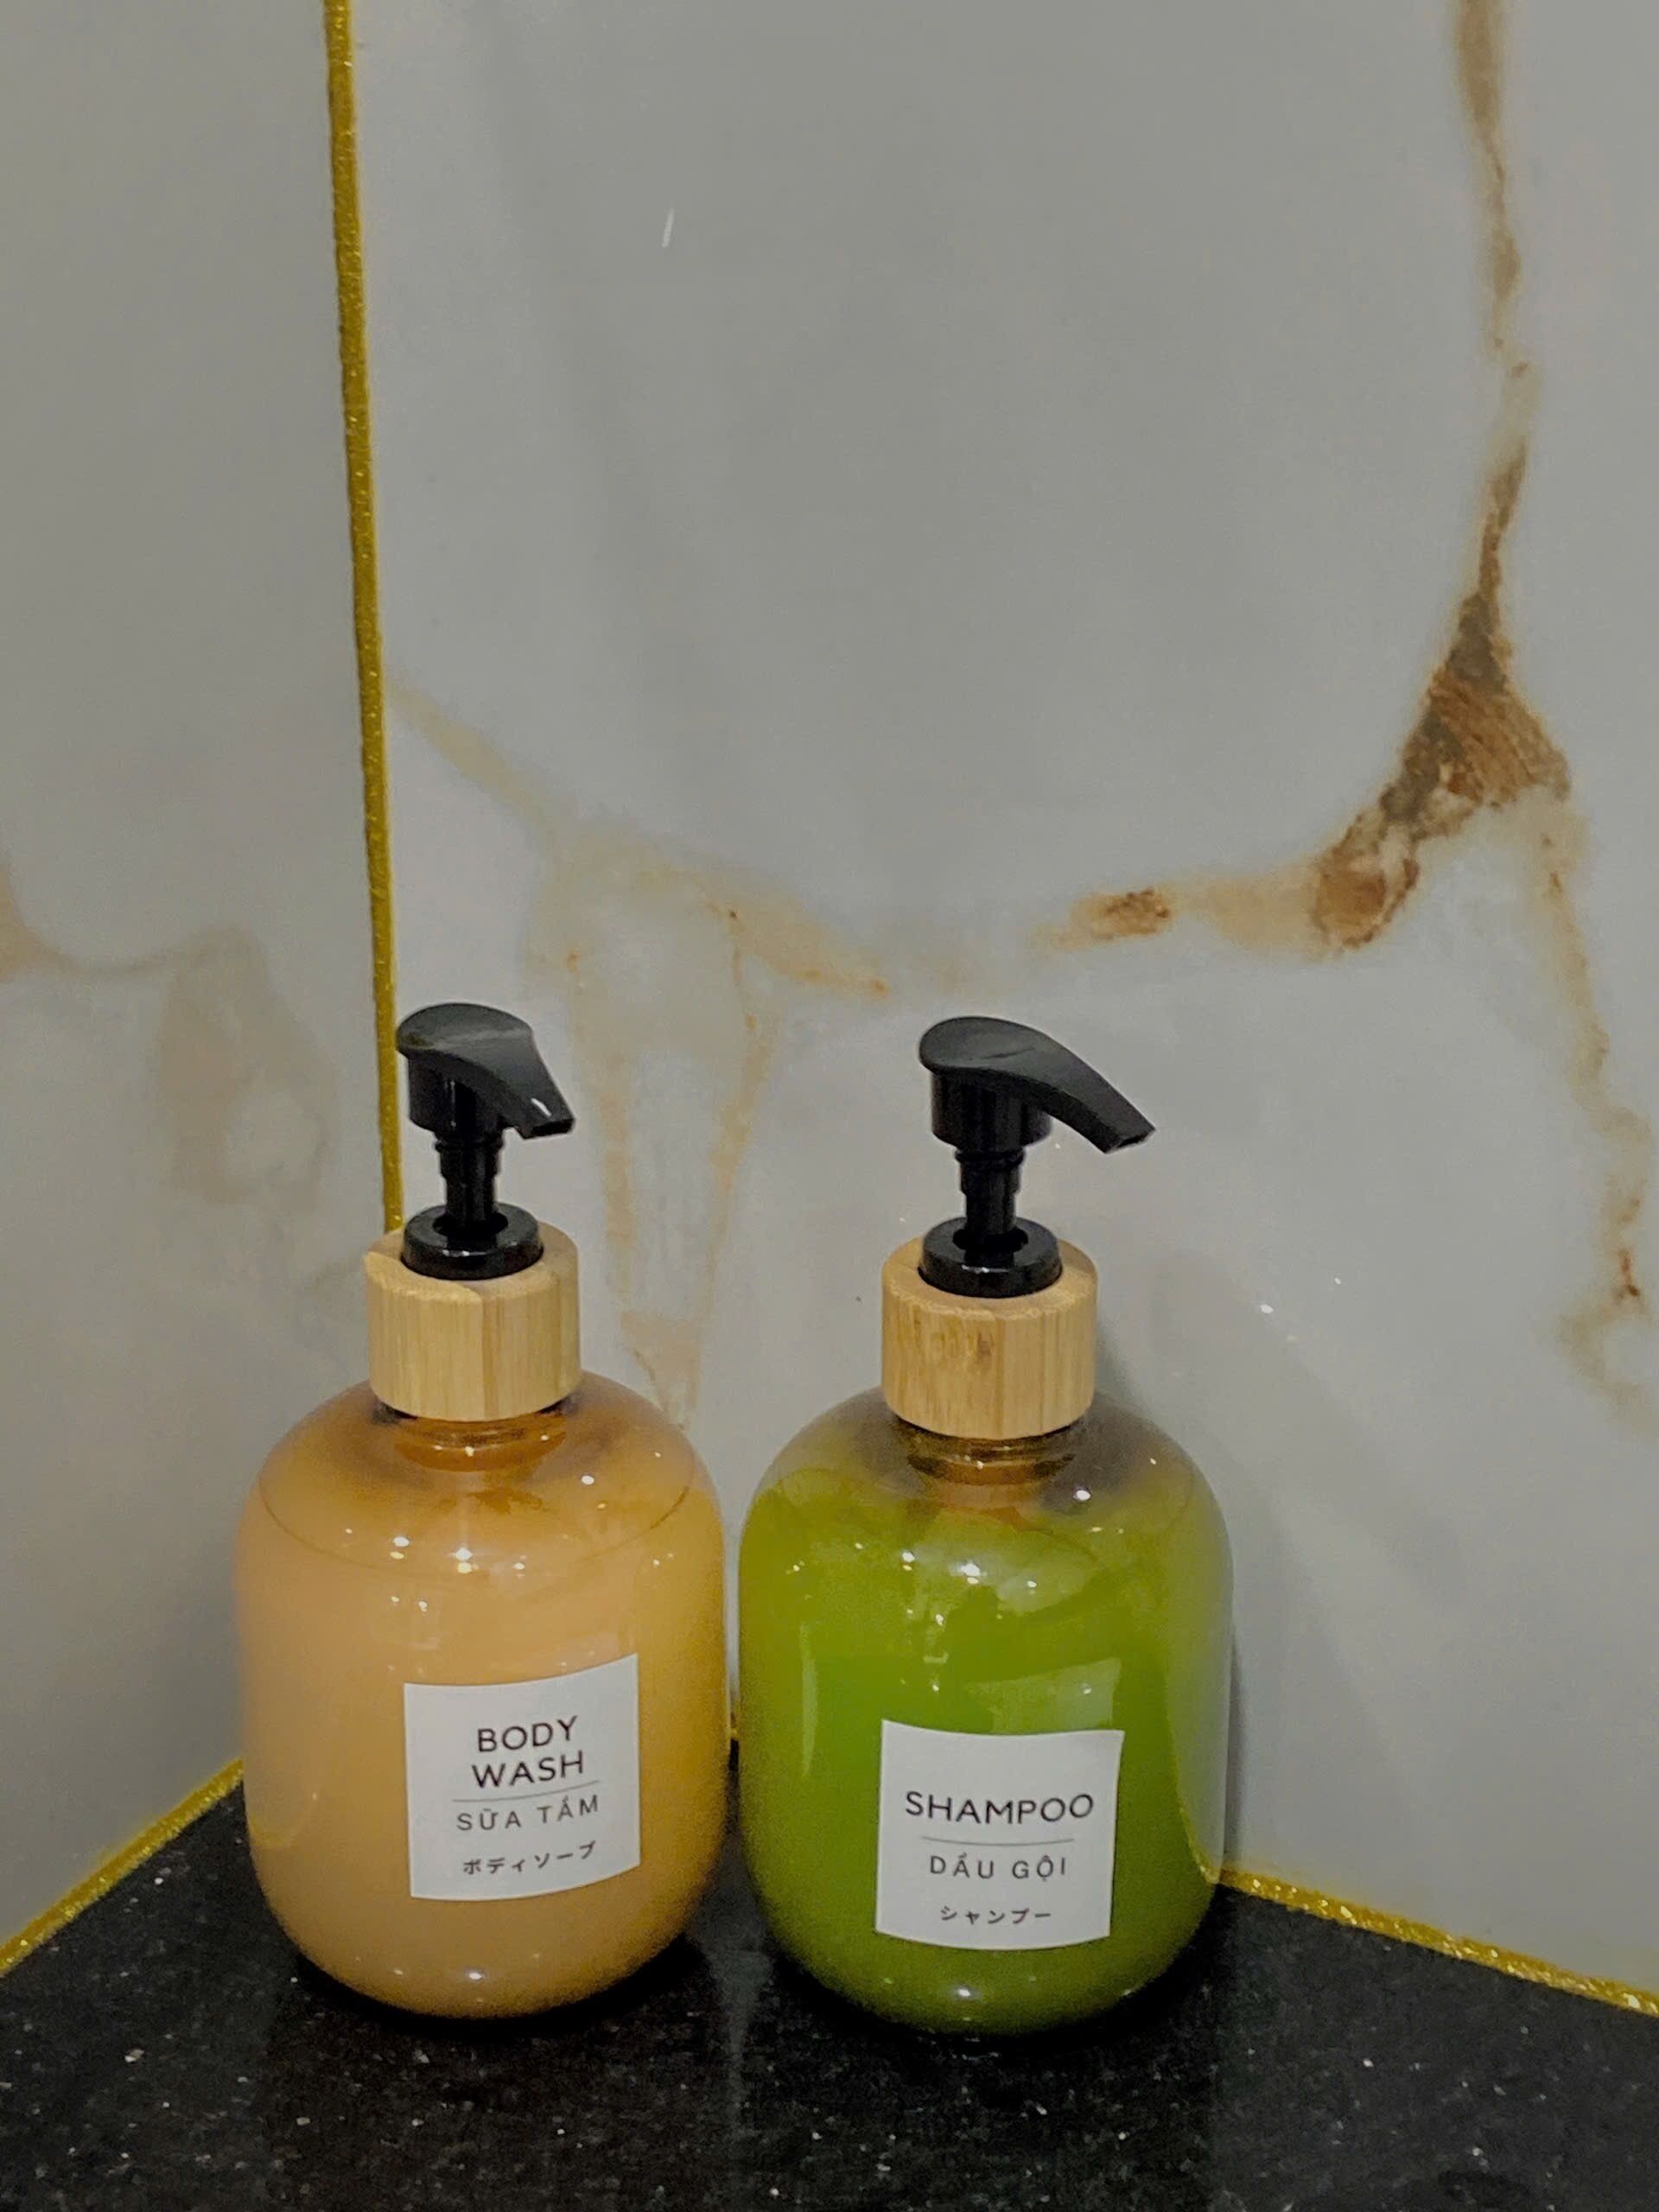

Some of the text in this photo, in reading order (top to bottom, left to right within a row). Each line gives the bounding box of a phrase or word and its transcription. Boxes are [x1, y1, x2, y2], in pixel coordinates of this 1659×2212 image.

[477, 1715, 578, 1753] BODY
[471, 1750, 584, 1789] WASH
[457, 1808, 522, 1831] SỮA
[906, 1790, 1094, 1824] SHAMPOO
[1012, 1854, 1066, 1882] GỘI
